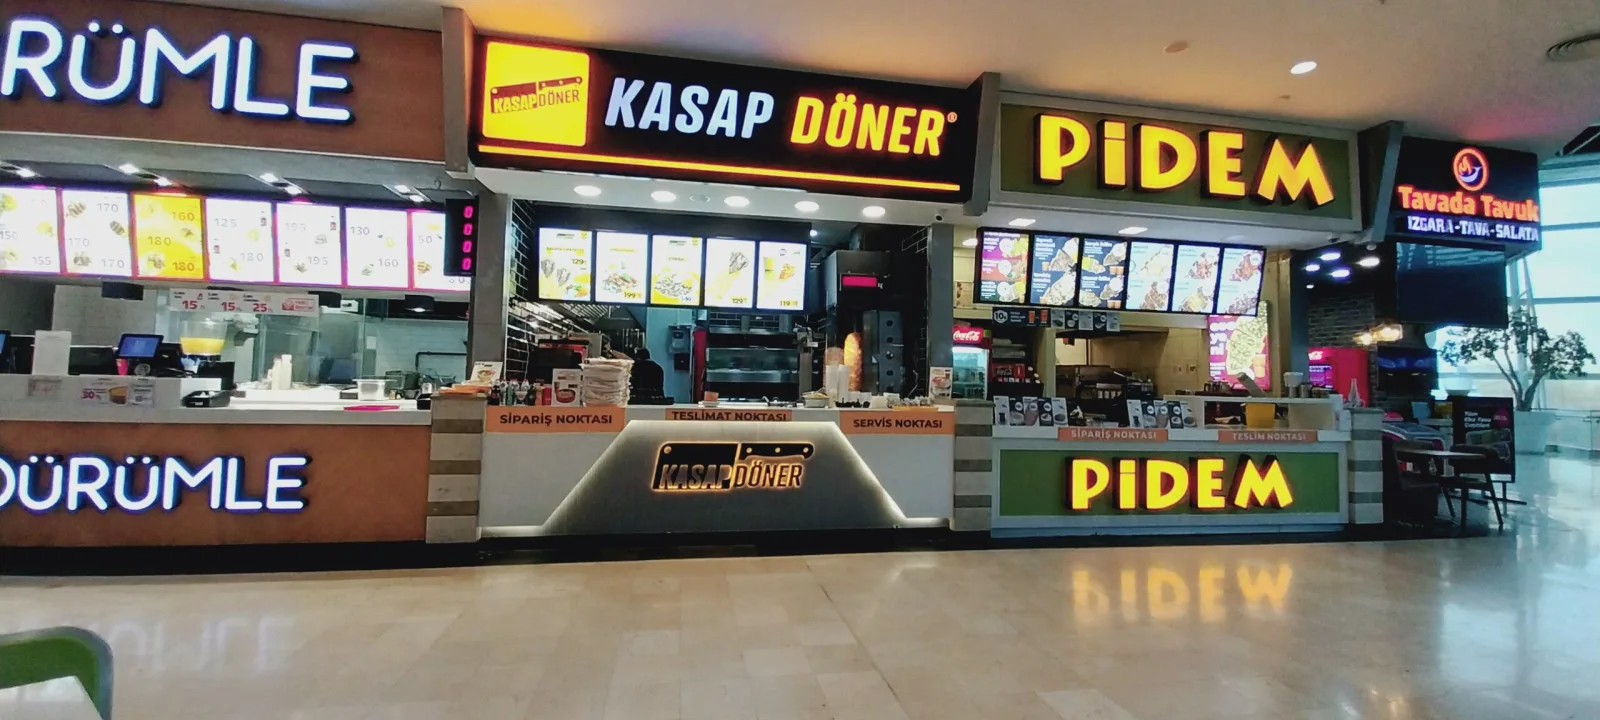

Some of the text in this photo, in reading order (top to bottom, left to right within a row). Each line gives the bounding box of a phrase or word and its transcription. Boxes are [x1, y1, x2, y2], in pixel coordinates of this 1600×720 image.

[1, 20, 355, 121] RÜMLE
[493, 89, 580, 114] KASAP DÖNER
[605, 76, 775, 140] KASAP
[97, 203, 119, 213] 170
[1397, 185, 1540, 222] Tavada Tavuk
[171, 211, 195, 222] 160
[214, 218, 237, 228] 125
[350, 225, 371, 236] 130
[147, 236, 172, 246] 180
[32, 256, 52, 266] 155
[101, 259, 125, 269] 170
[171, 261, 195, 272] 180
[377, 258, 399, 268] 160
[182, 300, 198, 310] 15
[220, 301, 236, 312] 15
[252, 303, 268, 313] 25
[499, 412, 613, 427] SİPARİŞ NOKTASI
[672, 409, 787, 422] TESLİMAT NOKTASI
[853, 417, 943, 429] SERVİS NOKTASI
[1071, 429, 1157, 440] SİPARİŞ NOKTASI
[1232, 431, 1307, 441] TESLİM NOKTASI
[658, 460, 803, 490] KASAP DÖNER
